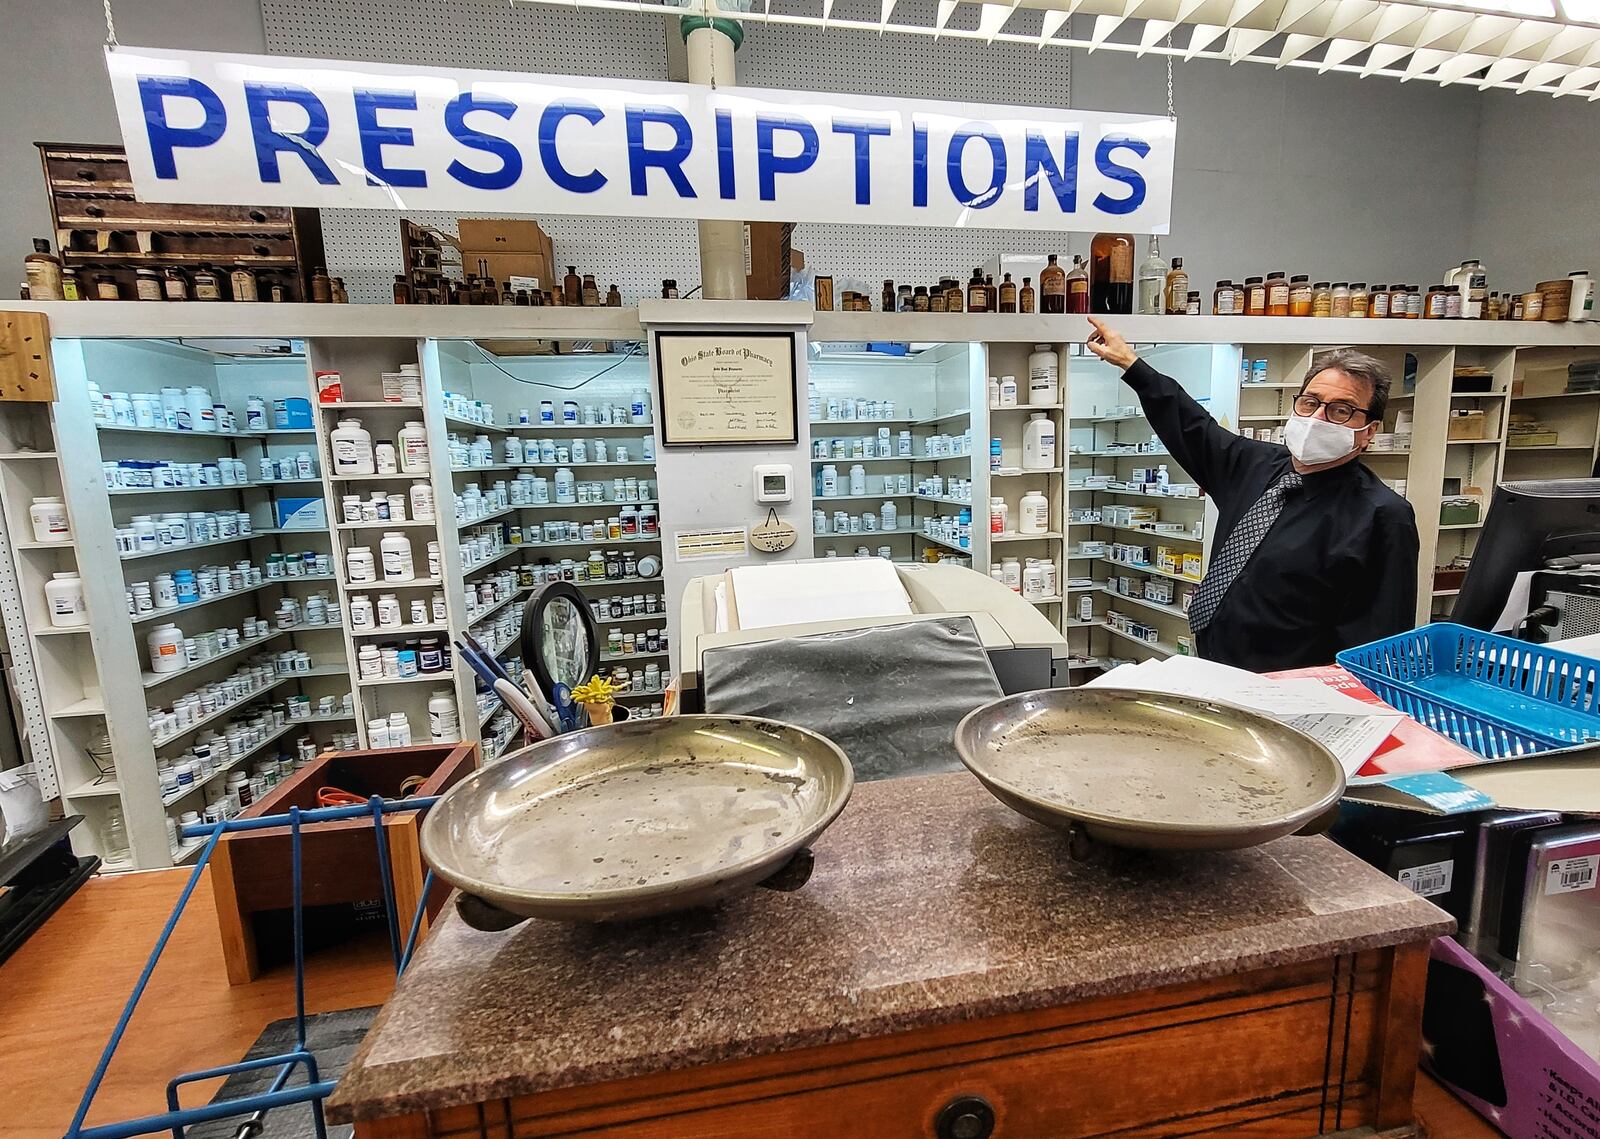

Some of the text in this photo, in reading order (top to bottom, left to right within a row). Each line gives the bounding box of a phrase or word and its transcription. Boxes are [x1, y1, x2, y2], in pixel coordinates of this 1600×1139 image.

[136, 73, 1151, 215] PRESCRIPTIONS
[681, 354, 697, 367] Ohio
[698, 349, 714, 360] State
[715, 346, 734, 356] Board
[743, 347, 773, 367] Pharmacy
[1549, 1069, 1584, 1099] Keeps
[1543, 1110, 1571, 1135] Hard
